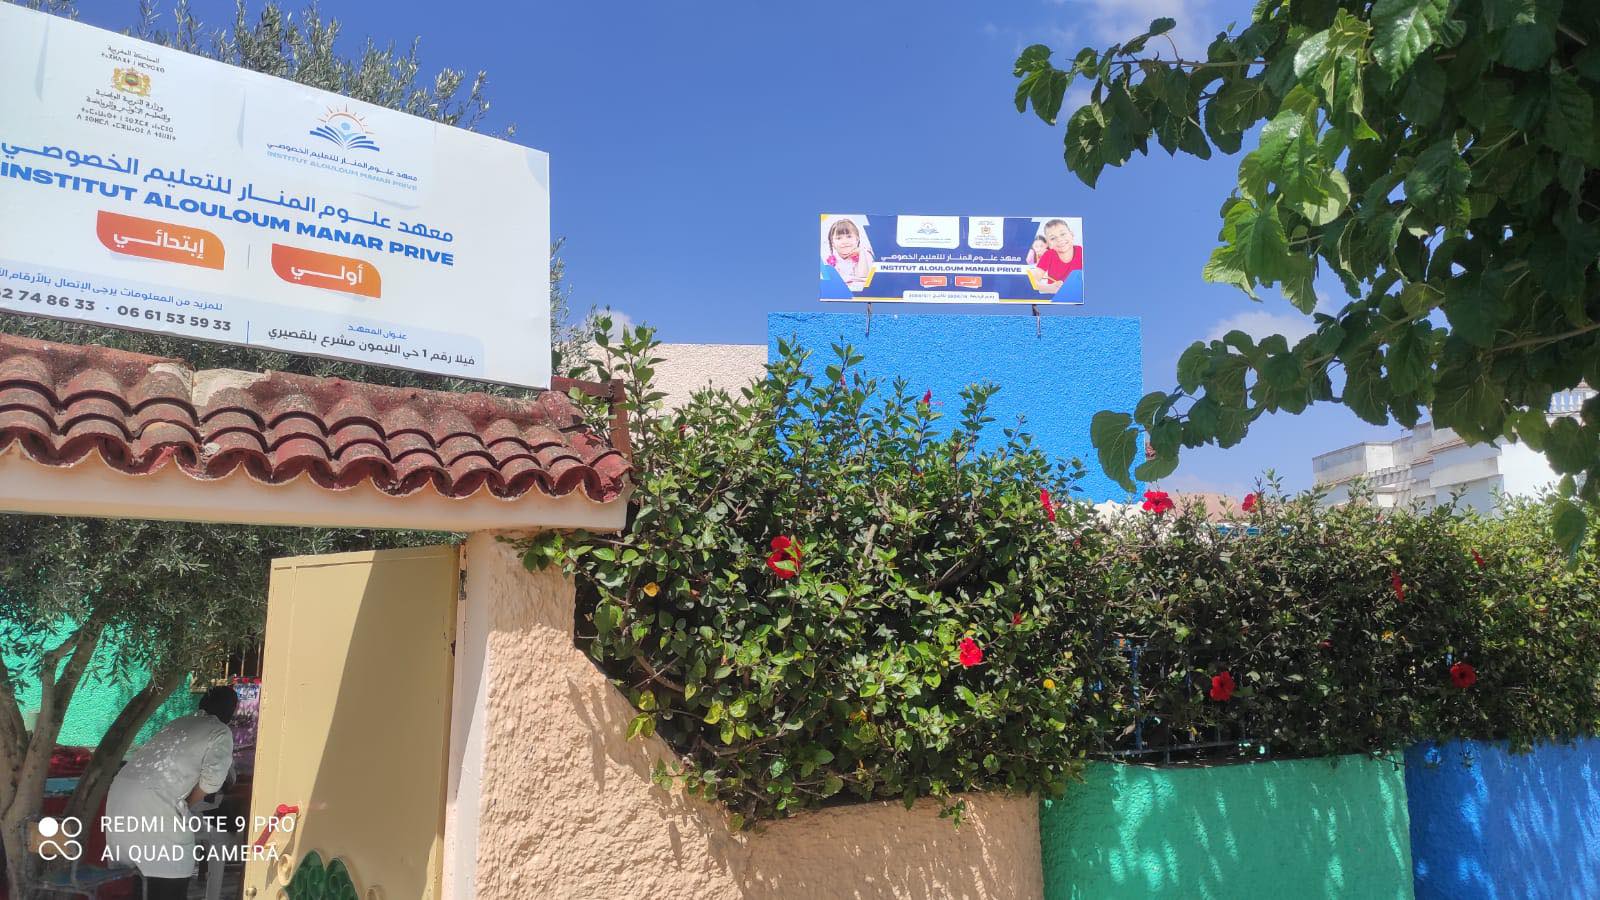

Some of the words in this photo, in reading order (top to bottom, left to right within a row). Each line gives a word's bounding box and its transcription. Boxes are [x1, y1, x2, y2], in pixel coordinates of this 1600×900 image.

[266, 143, 309, 156] الخصوصي
[1, 141, 139, 176] الخصوصي
[309, 151, 339, 162] للتعليم
[341, 157, 368, 169] المنار
[368, 165, 395, 176] علوم
[396, 172, 418, 182] معهد
[143, 166, 232, 195] للتعليم
[237, 183, 316, 212] المنار
[0, 161, 138, 201] INSTITUT
[143, 191, 290, 233] ALOULOUM
[296, 221, 384, 252] MANAR
[389, 240, 454, 266] PRIVE
[318, 204, 391, 229] علوم
[397, 220, 453, 243] معهد
[113, 229, 204, 260] إبتدائي
[881, 252, 918, 262] الخصوصي
[919, 253, 945, 262] للتعليم
[946, 253, 972, 262] المنار
[973, 253, 998, 263] علوم
[1000, 254, 1022, 262] معهد
[9, 271, 51, 287] بالأرقام
[290, 264, 363, 286] أولي
[54, 276, 91, 294] الإتصال
[93, 284, 117, 297] يرجى
[0, 288, 13, 299] 2
[19, 290, 42, 303] 74
[46, 295, 70, 307] 86
[75, 298, 95, 311] 33
[120, 287, 173, 304] المعلومات
[176, 297, 190, 307] من
[193, 301, 223, 311] للمزيد
[117, 305, 139, 318] 06
[145, 310, 161, 321] 61
[166, 312, 186, 324] 53
[190, 316, 209, 328] 59
[213, 320, 231, 331] 33
[268, 327, 317, 342] بلقصيري
[347, 324, 382, 337] المعهد
[384, 331, 408, 341] عنوان
[321, 334, 356, 348] مشرع
[359, 341, 401, 355] الليمون
[403, 348, 419, 358] حي
[430, 351, 452, 363] رقم
[455, 353, 475, 365] فيلا
